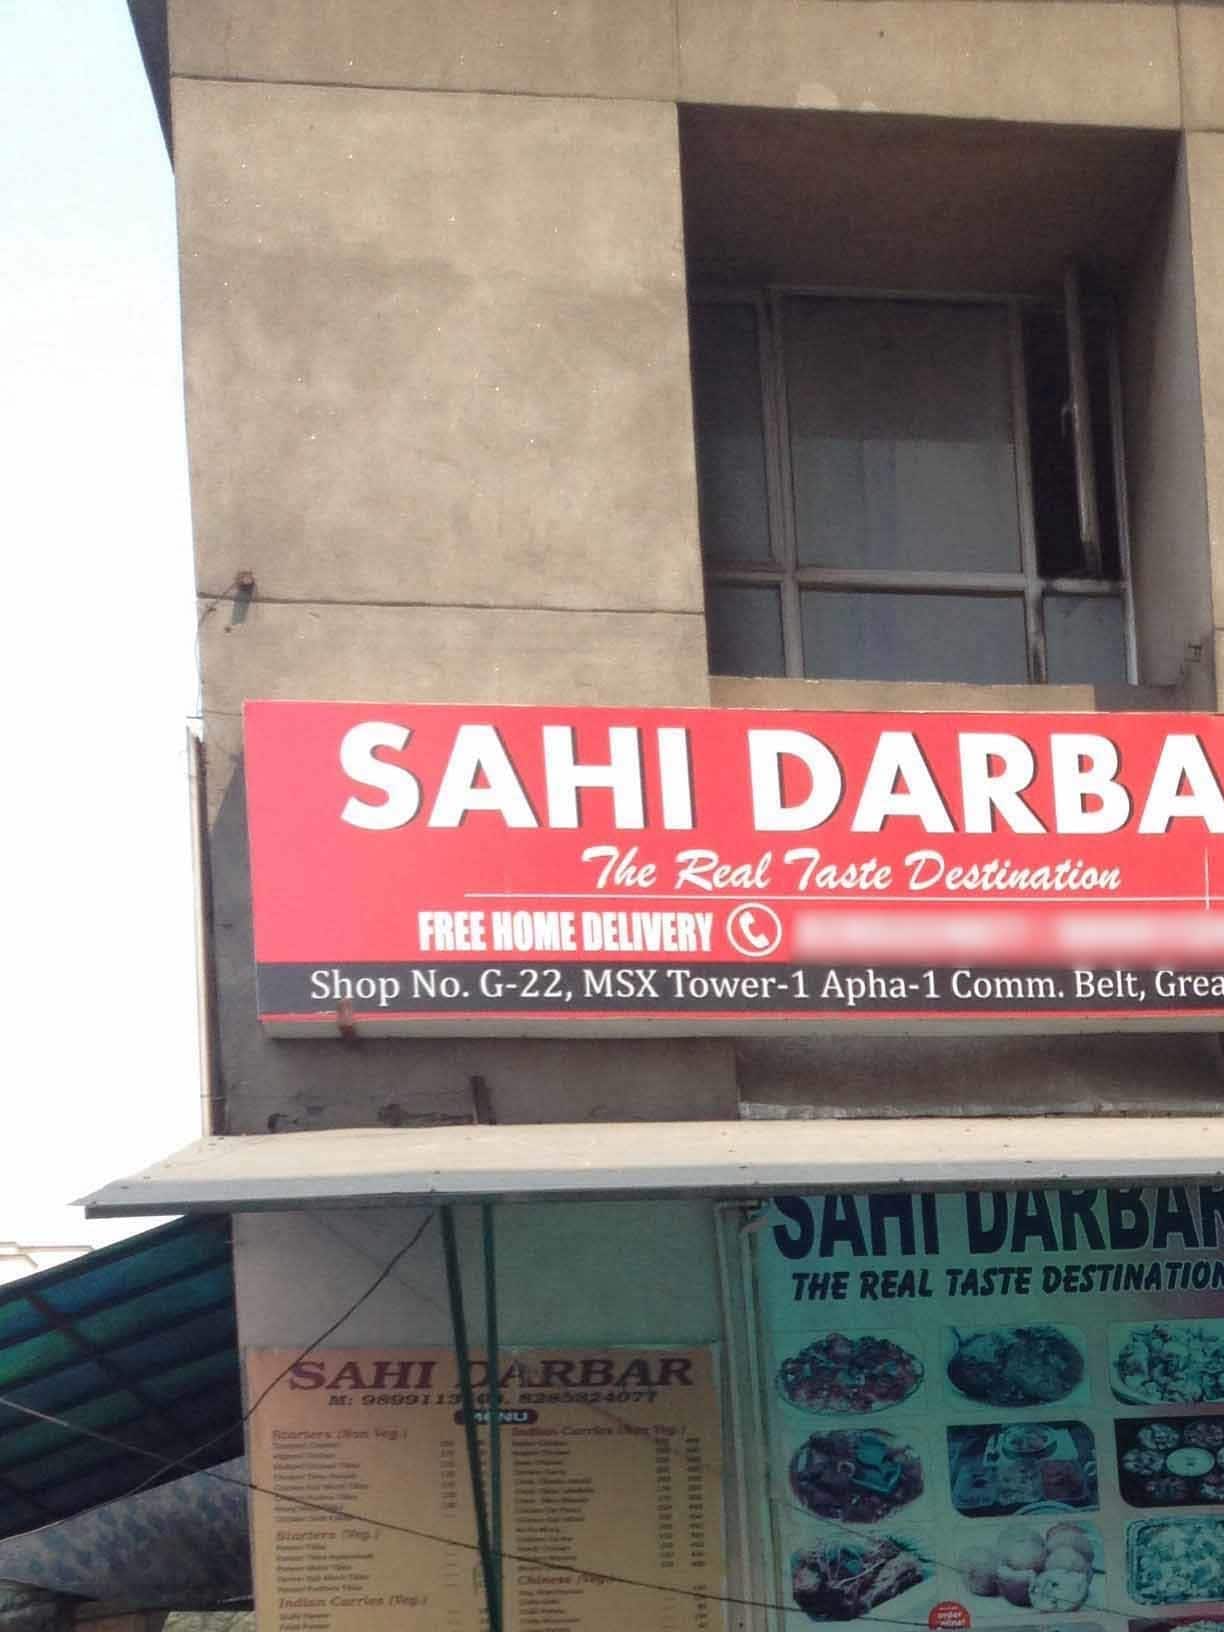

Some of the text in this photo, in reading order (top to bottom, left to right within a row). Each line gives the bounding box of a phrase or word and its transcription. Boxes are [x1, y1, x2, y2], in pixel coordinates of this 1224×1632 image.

[339, 720, 695, 832] SAHI
[581, 845, 1122, 891] The Real Taste Destination
[418, 911, 713, 952] FREE HOME DELIVERY
[310, 969, 400, 1006] Shop
[412, 969, 469, 999] No.
[480, 969, 573, 1002] G-22,
[583, 969, 658, 999] MSX
[666, 969, 809, 999] Tower-1
[821, 968, 938, 1005] Apha-1
[951, 969, 1064, 1000] Comm.
[1075, 969, 1146, 1002] Belt,
[772, 1194, 940, 1260] SAHI
[791, 1271, 850, 1301] THE
[859, 1269, 933, 1301] REAL
[945, 1265, 1034, 1297] TASTE
[288, 1360, 438, 1391] SAHI
